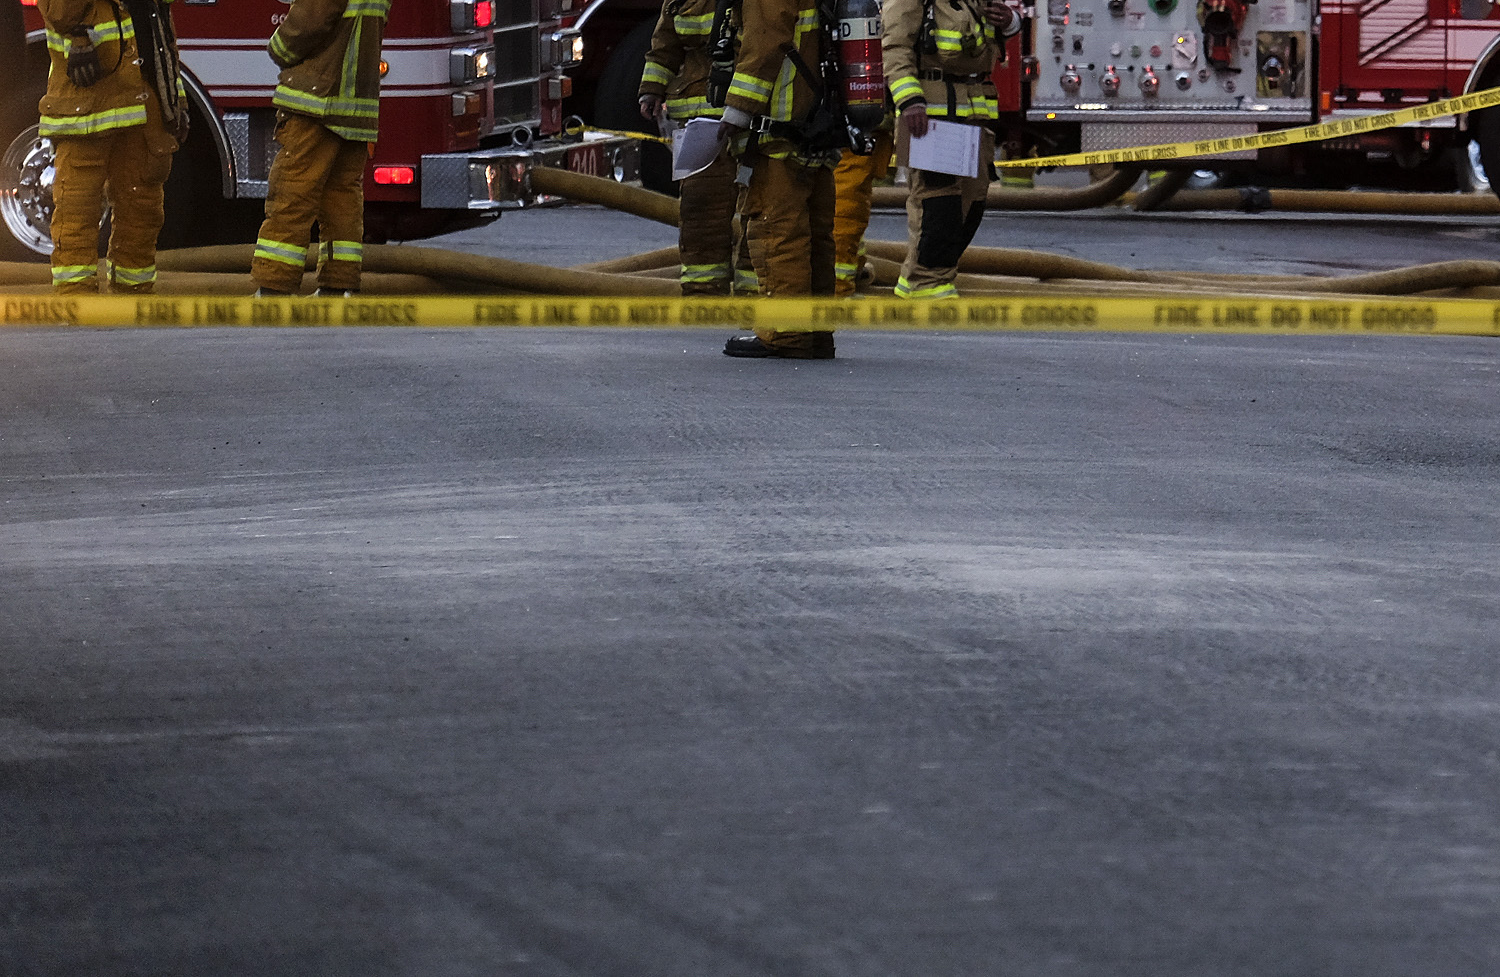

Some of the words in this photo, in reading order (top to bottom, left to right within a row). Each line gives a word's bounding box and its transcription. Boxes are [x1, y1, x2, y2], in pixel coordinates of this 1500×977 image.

[1412, 106, 1429, 119] FIRE
[1431, 102, 1447, 115] LINE
[1449, 99, 1461, 111] DO
[1461, 96, 1477, 108] NOT
[1304, 126, 1319, 138] FIRE
[1322, 123, 1339, 136] LINE
[1341, 120, 1352, 133] DO
[1353, 117, 1368, 130] NOT
[1371, 112, 1396, 127] CROSS
[1195, 142, 1210, 153] FIRE
[1213, 139, 1229, 151] LINE
[1232, 137, 1242, 149] DO
[1244, 135, 1259, 147] NOT
[1261, 131, 1288, 145] CROSS
[1085, 155, 1100, 164] FIRE
[1103, 152, 1119, 164] LINE
[1122, 151, 1132, 162] DO
[1134, 149, 1149, 161] NOT
[1152, 146, 1177, 160] CROSS
